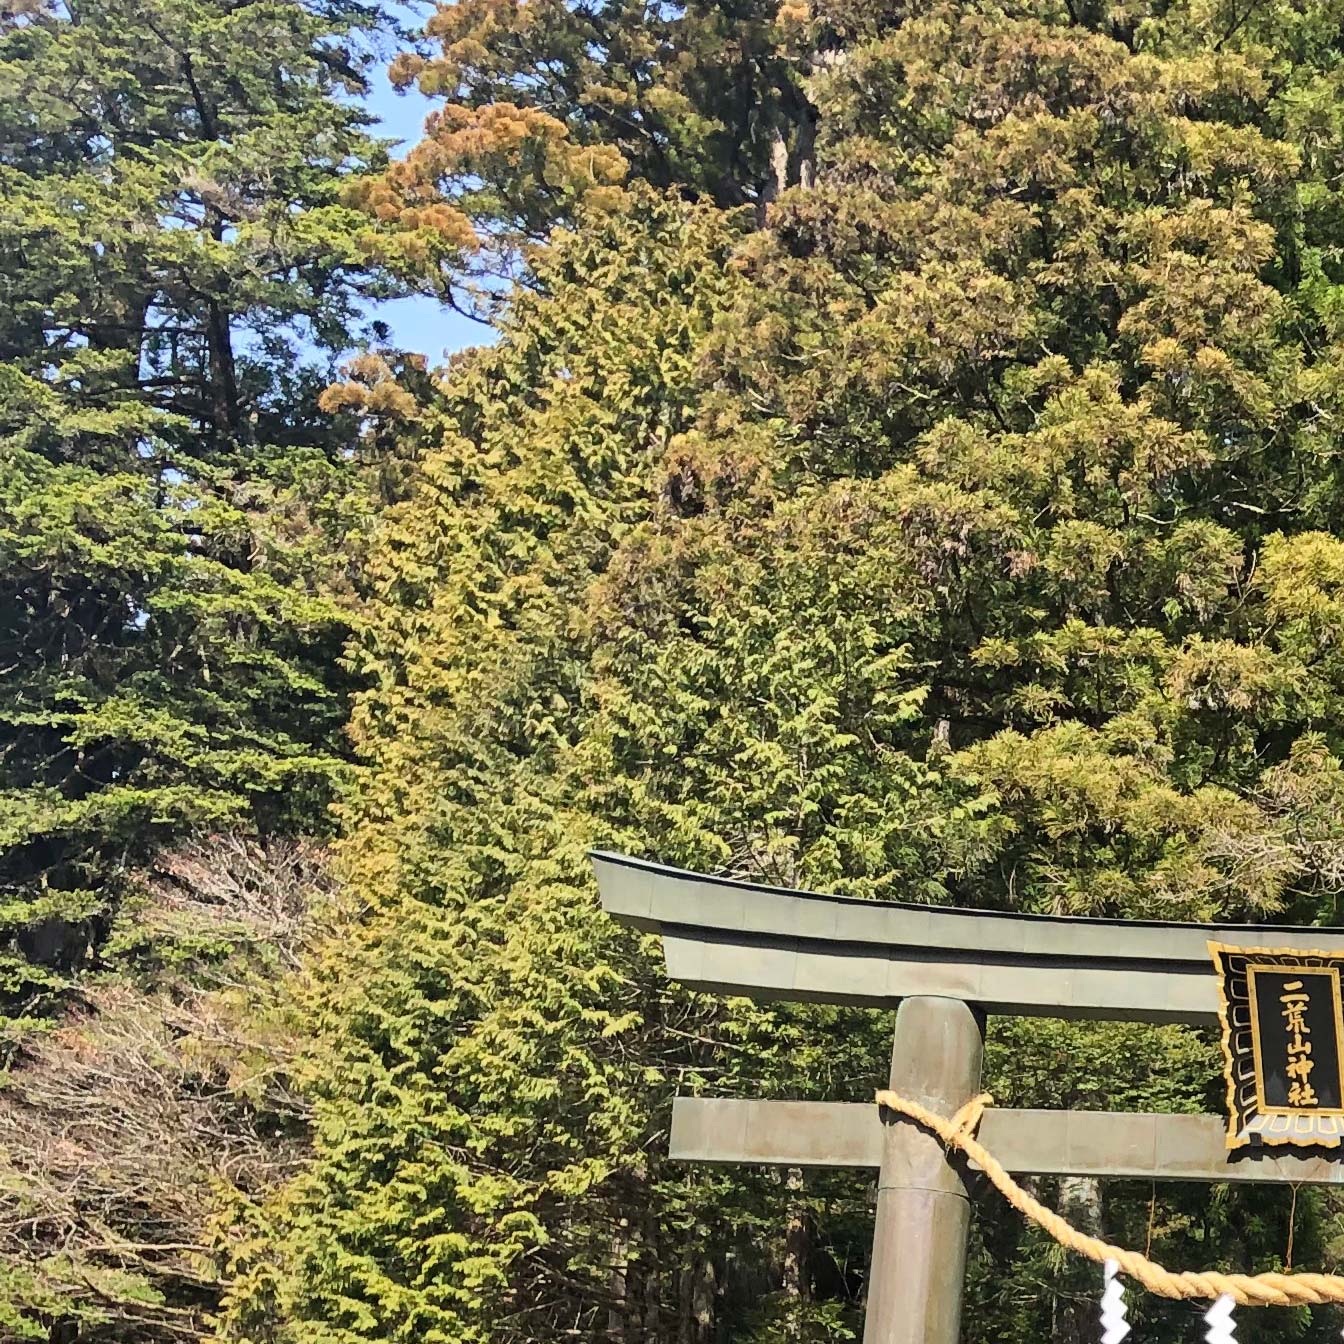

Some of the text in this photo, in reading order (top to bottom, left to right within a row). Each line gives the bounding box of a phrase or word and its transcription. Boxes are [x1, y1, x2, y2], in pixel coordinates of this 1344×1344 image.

[1279, 981, 1319, 1107] 二荒山神社
